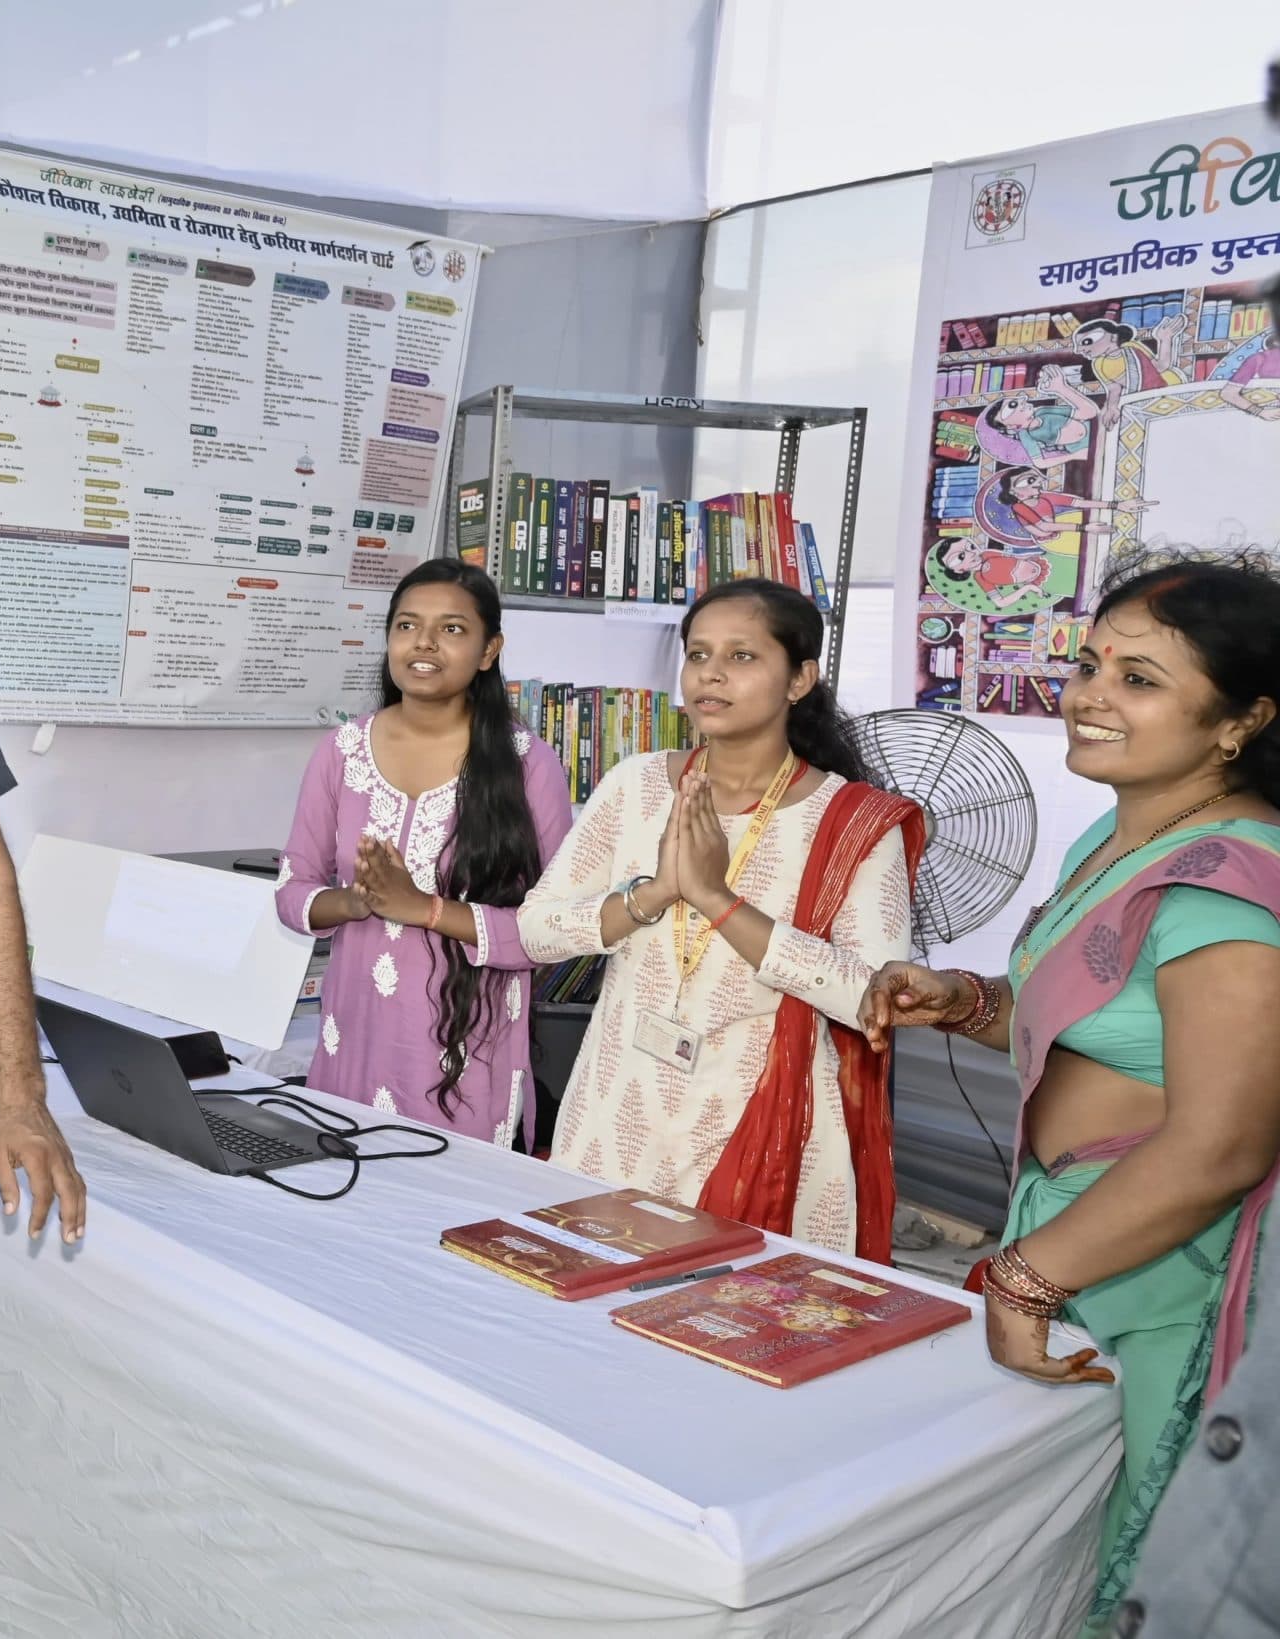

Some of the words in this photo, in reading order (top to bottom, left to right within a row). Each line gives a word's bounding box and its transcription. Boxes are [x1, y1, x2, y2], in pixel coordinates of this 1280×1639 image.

[40, 168, 92, 191] जीविका
[48, 189, 106, 220] विकास,
[109, 204, 167, 228] उद्यमिता
[168, 216, 181, 231] व
[184, 215, 235, 241] रोजगार
[237, 224, 262, 250] हेतु
[263, 231, 306, 253] करियर
[309, 239, 368, 265] मार्गदर्शन
[372, 252, 395, 270] चार्ट
[1039, 240, 1203, 293] सामुदायिक
[460, 493, 484, 513] CDS
[515, 520, 527, 551] CDS
[673, 511, 685, 563] अंकगणित
[590, 550, 603, 569] CAT
[785, 544, 797, 569] CSAT
[807, 545, 821, 576] सामान्य
[754, 803, 769, 822] DMI
